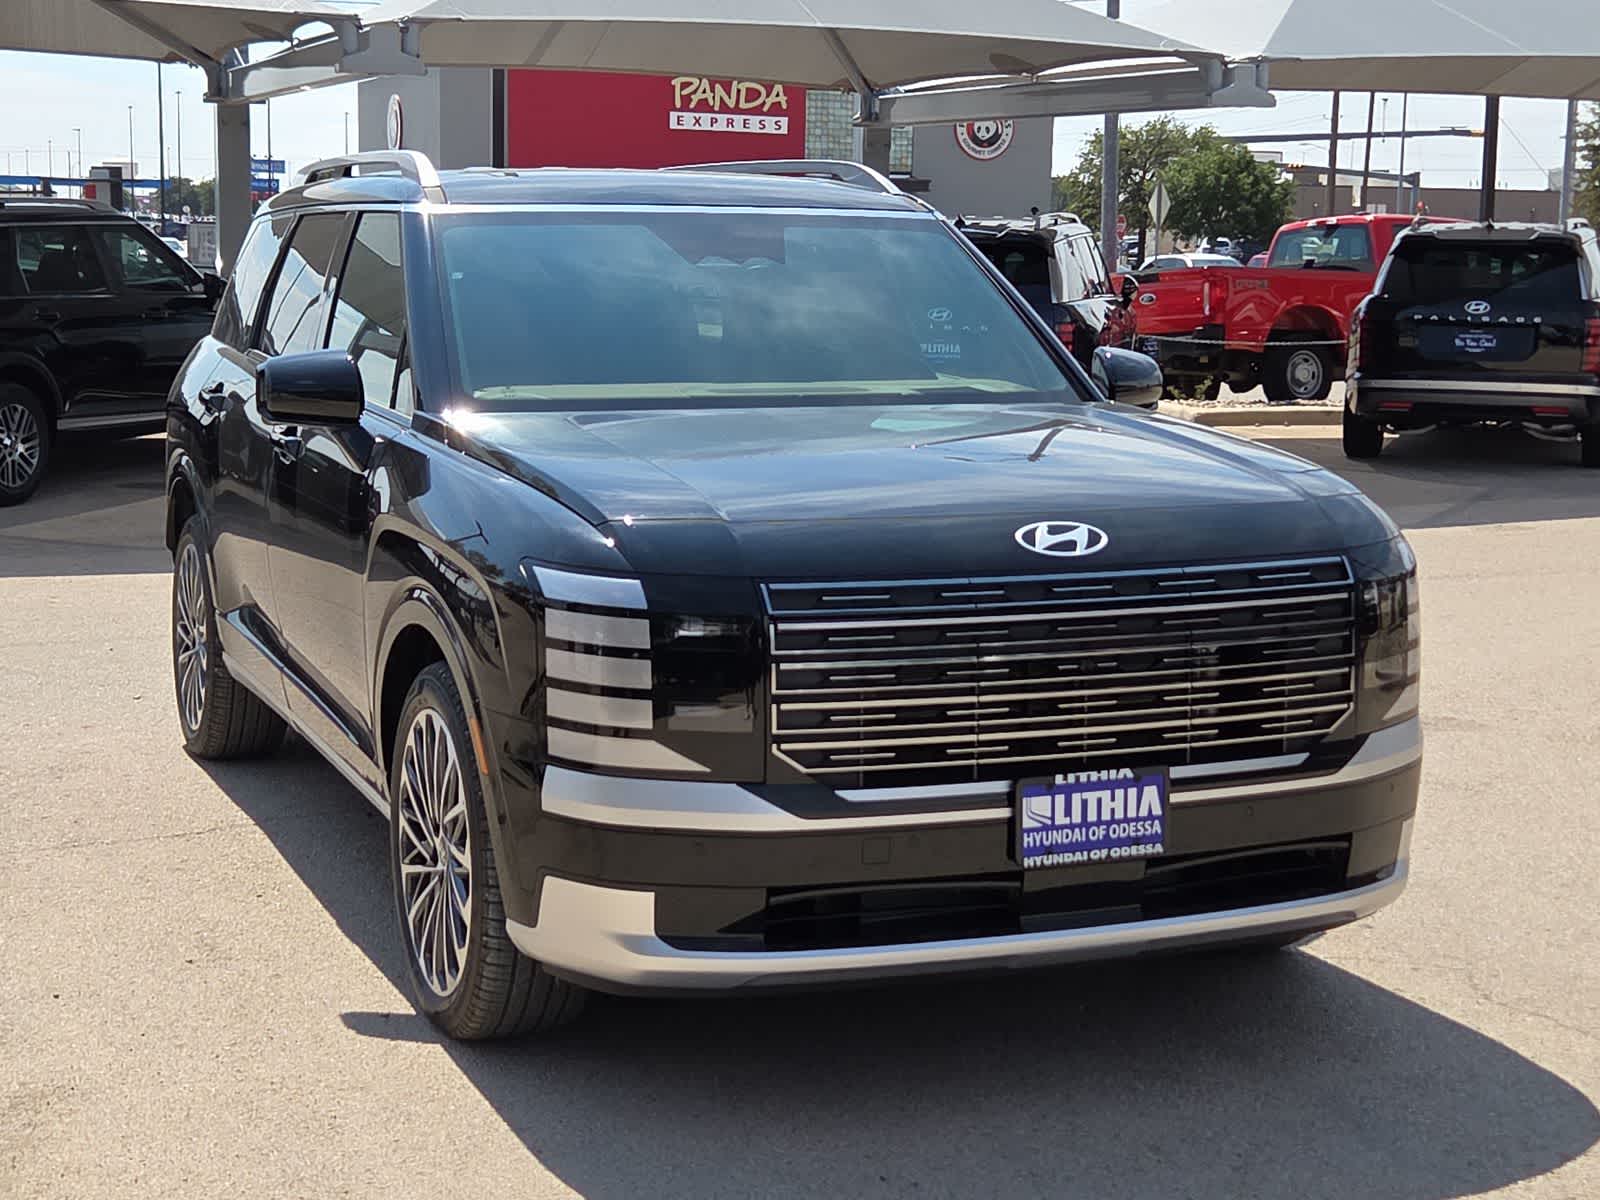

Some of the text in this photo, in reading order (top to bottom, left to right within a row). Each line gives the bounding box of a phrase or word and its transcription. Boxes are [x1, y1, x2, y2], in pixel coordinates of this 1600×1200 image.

[671, 76, 788, 112] PANDA
[676, 115, 782, 131] EXPRESS
[1055, 768, 1134, 785] LITHIA
[1054, 785, 1163, 826] LITHIA
[1023, 819, 1162, 848] HYUNDAI OF ODESSA
[1023, 842, 1164, 869] HYUNDAI OF ODESSA
